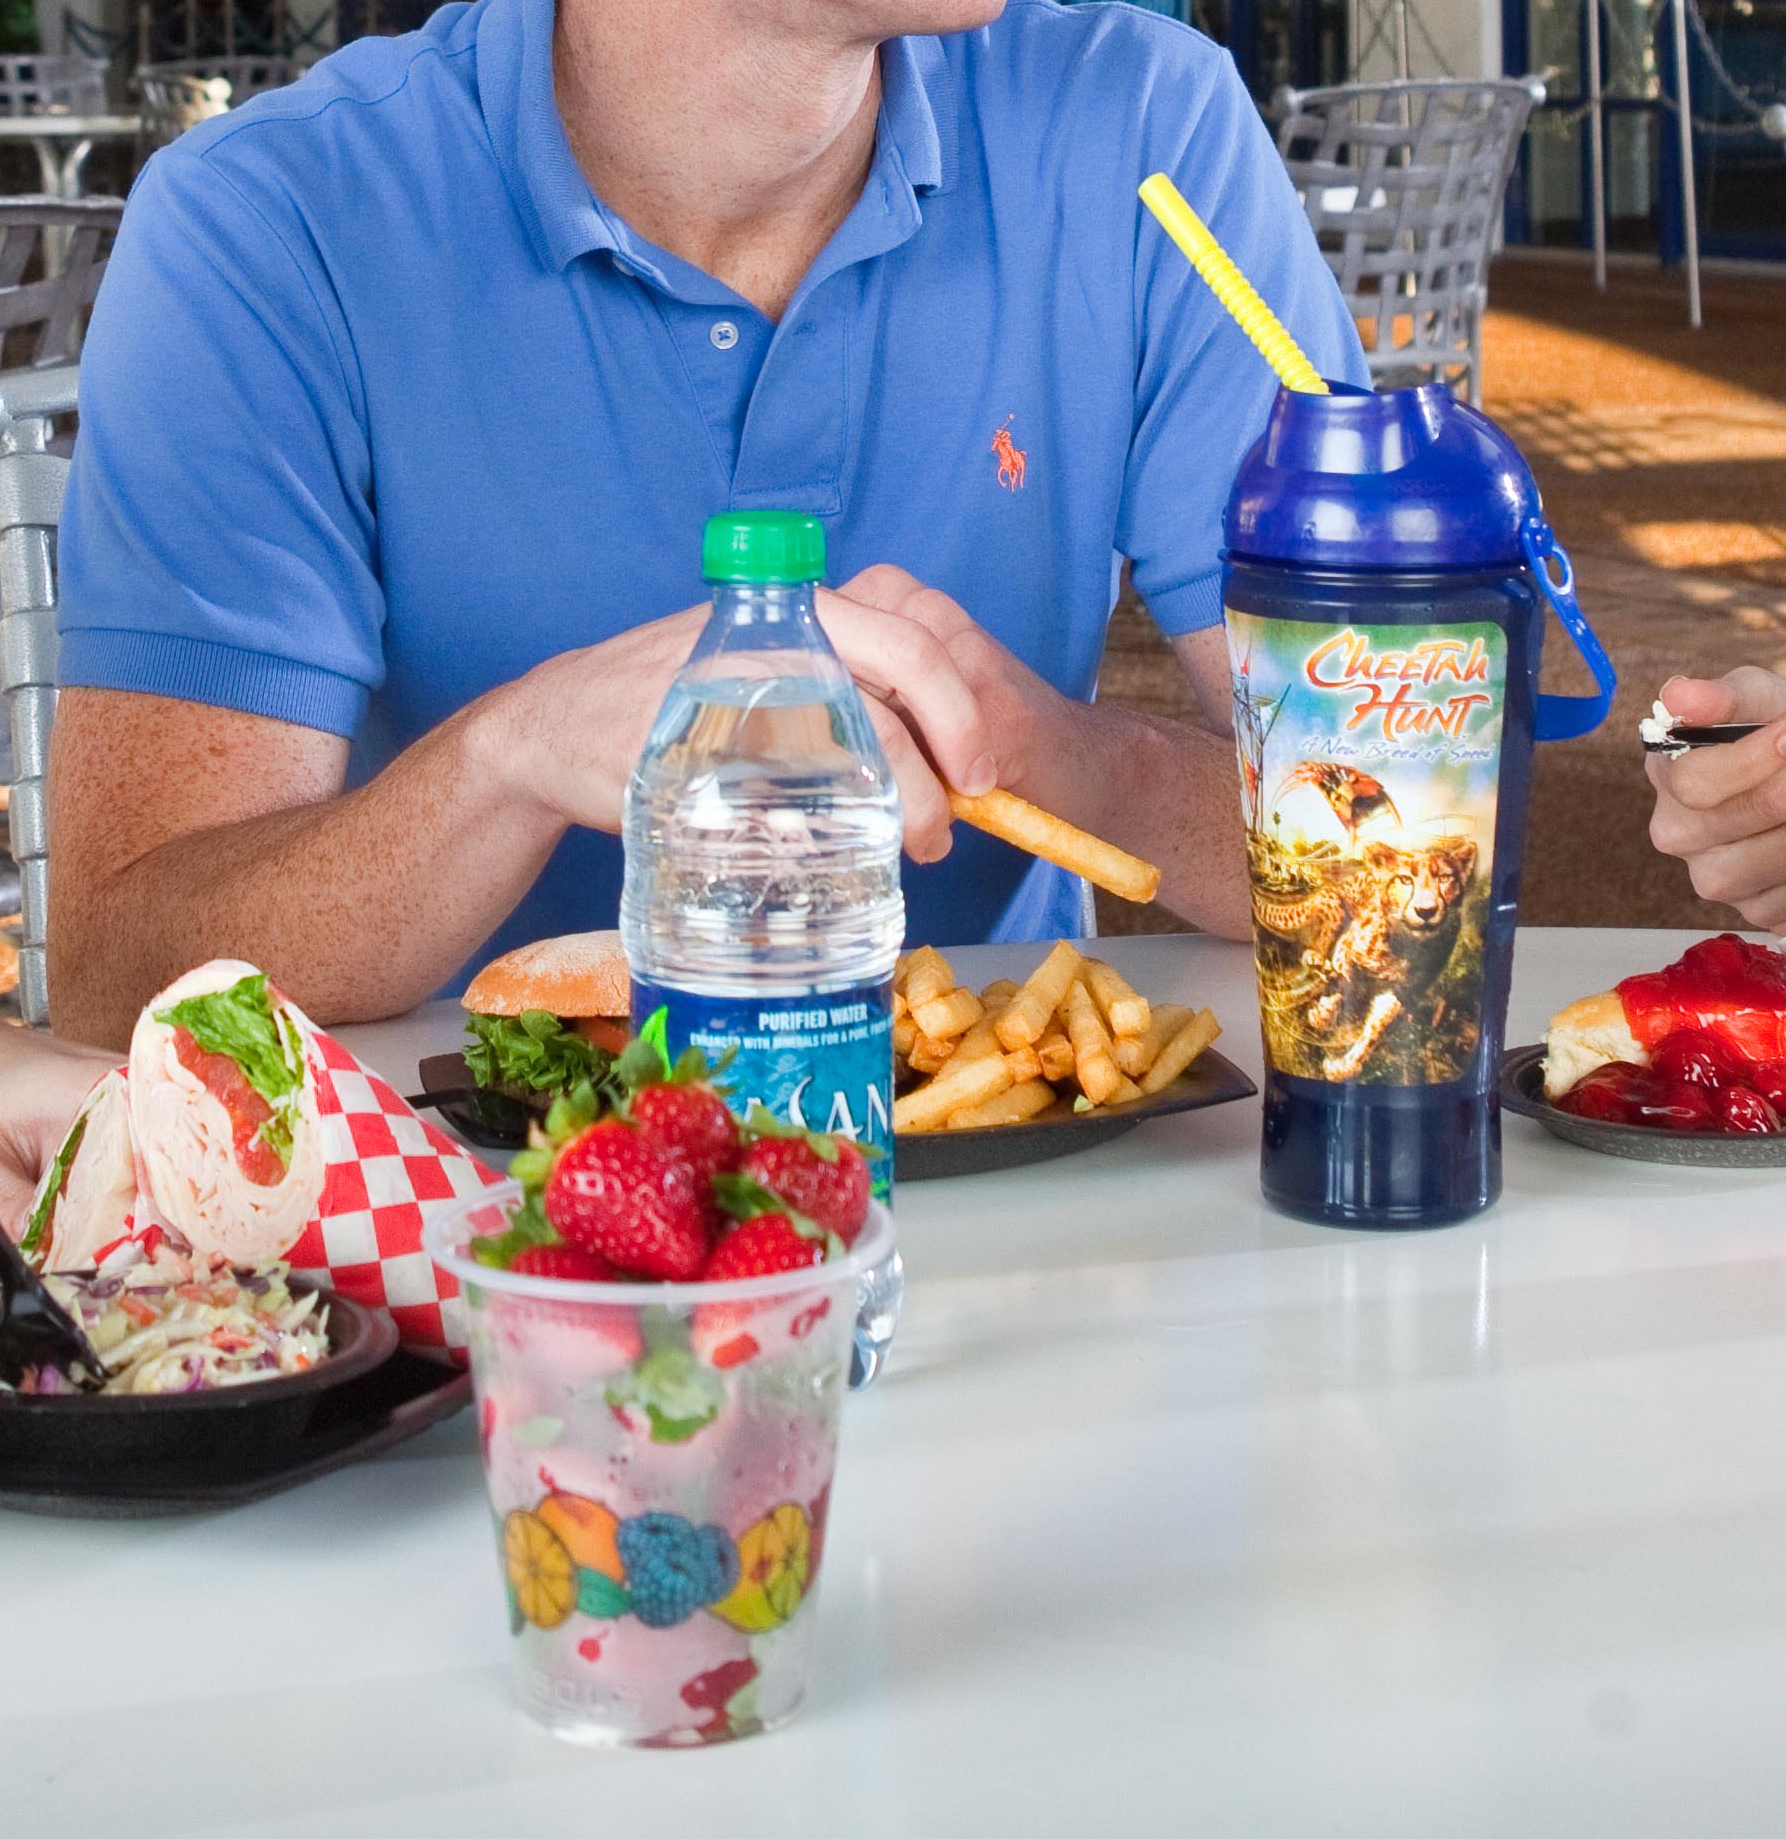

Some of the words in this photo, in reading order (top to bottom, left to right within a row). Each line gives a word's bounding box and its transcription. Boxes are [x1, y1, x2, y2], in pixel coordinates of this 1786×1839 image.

[1320, 737, 1360, 756] New
[1365, 741, 1420, 760] Breed
[1424, 744, 1445, 762] of
[758, 1008, 827, 1031] PURIFIED
[829, 1002, 868, 1027] WATER
[743, 1036, 771, 1050] WITH
[820, 1031, 839, 1046] FOR
[840, 1029, 848, 1043] A
